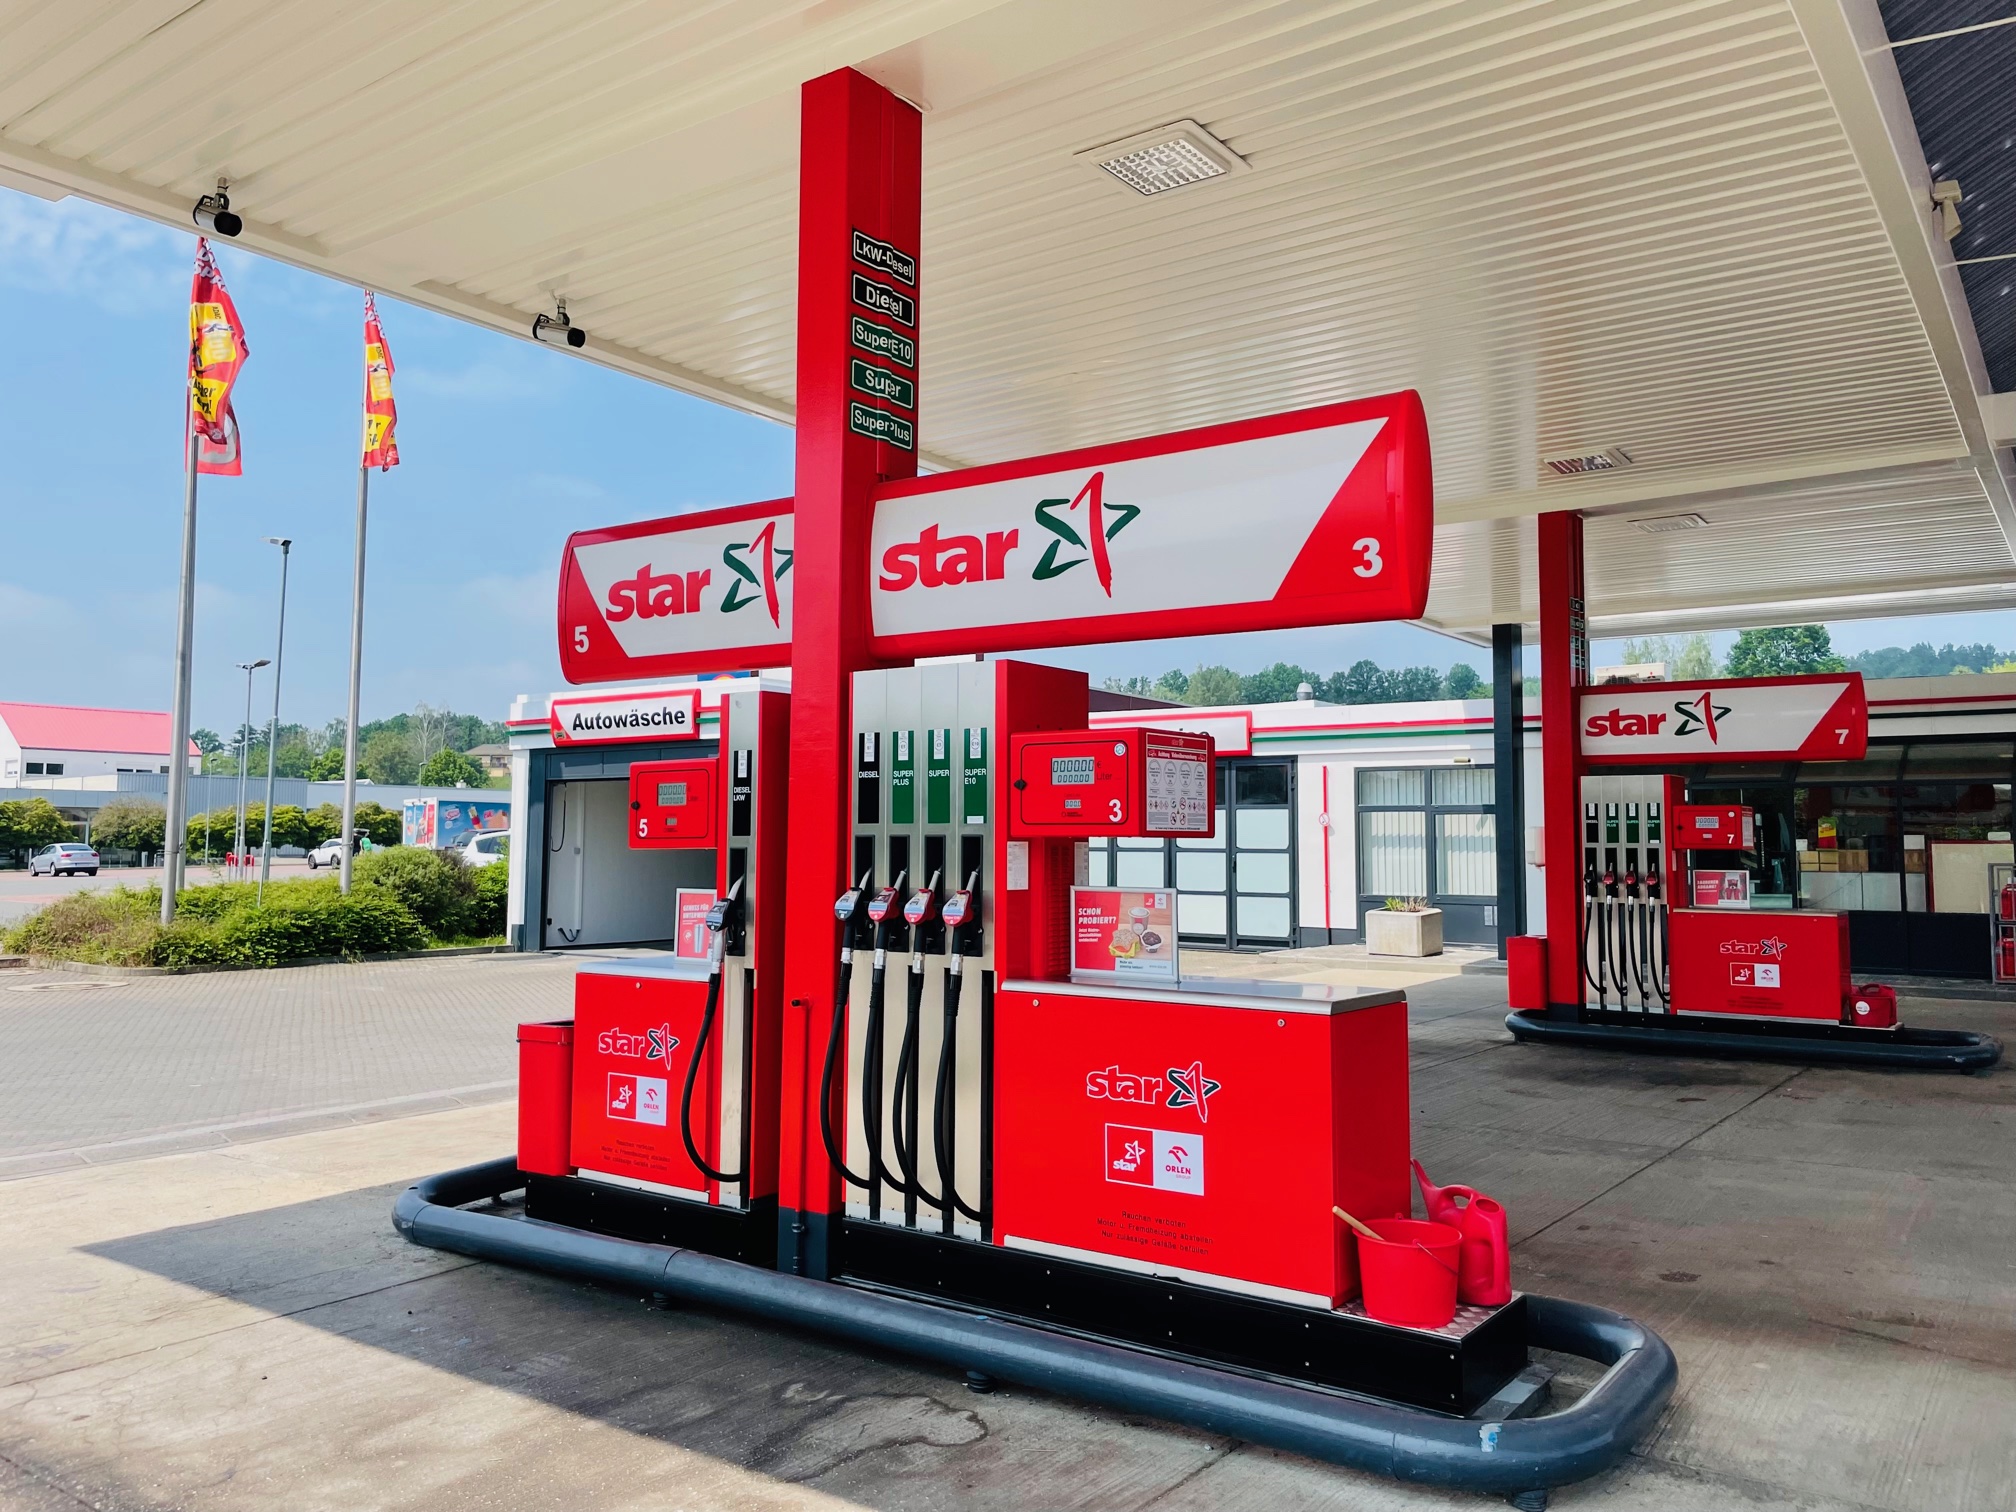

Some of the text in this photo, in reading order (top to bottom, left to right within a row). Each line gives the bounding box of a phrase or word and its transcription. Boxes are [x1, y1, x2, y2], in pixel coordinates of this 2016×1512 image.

[856, 239, 911, 277] LKW-Desel
[879, 523, 1019, 592] star
[1352, 537, 1383, 578] 3
[605, 563, 711, 622] star
[574, 625, 589, 653] 5
[572, 707, 686, 731] Autowäsche
[1585, 707, 1666, 737] star
[1835, 728, 1849, 745] 7
[858, 770, 880, 778] DIESEL
[893, 770, 914, 778] SUPER
[928, 769, 950, 777] SUPER
[964, 768, 986, 776] SUPER
[892, 778, 910, 786] PLUS
[964, 777, 977, 785] E10
[733, 786, 751, 794] DIESEL
[1108, 798, 1122, 822] 3
[638, 818, 648, 838] 5
[1727, 833, 1734, 844] 7
[1078, 907, 1101, 916] SCHON
[1078, 916, 1117, 924] PROBIERT?
[1720, 940, 1759, 955] star
[598, 1027, 645, 1057] star
[1086, 1064, 1162, 1104] star
[1112, 1159, 1136, 1172] star
[1165, 1164, 1191, 1175] ORLEN
[1122, 1210, 1186, 1228] Rauchen verboten
[1097, 1217, 1116, 1227] Motor
[1128, 1223, 1177, 1239] Fremdheizung
[1180, 1233, 1213, 1244] abstellen
[1102, 1230, 1113, 1238] Nur
